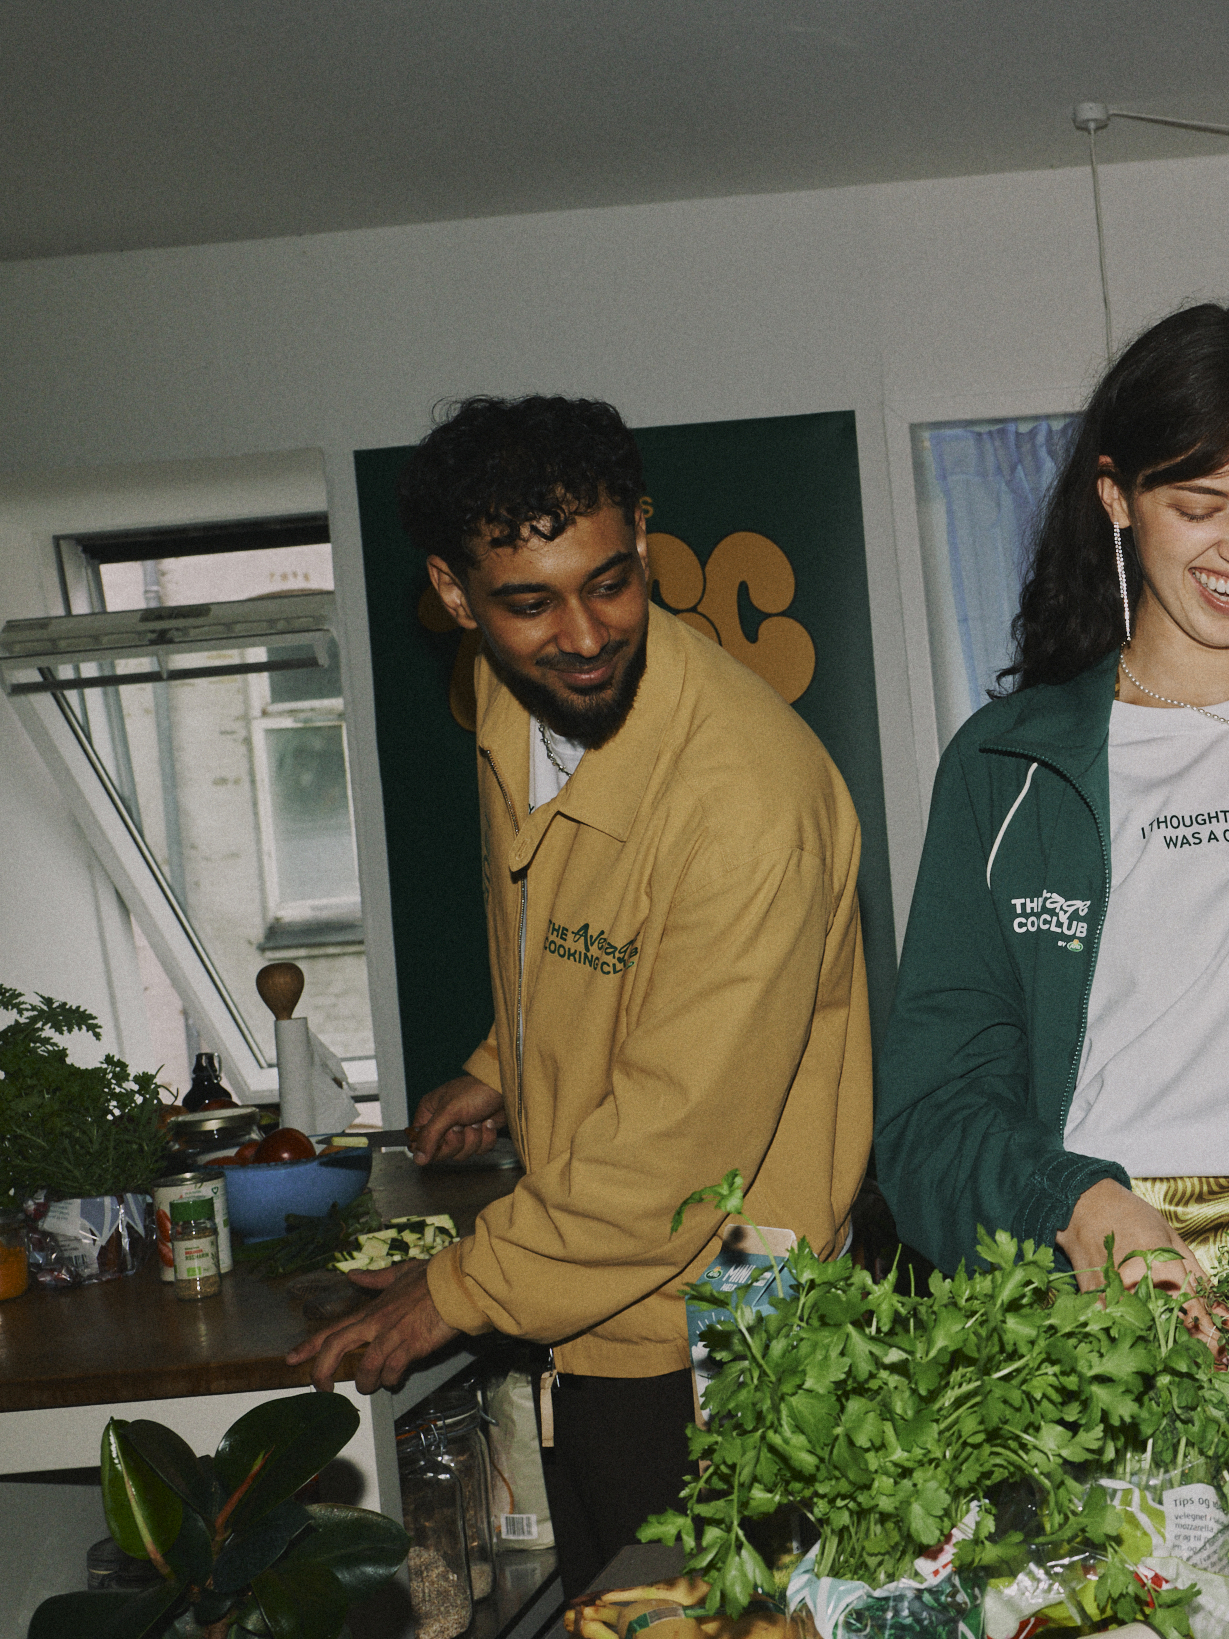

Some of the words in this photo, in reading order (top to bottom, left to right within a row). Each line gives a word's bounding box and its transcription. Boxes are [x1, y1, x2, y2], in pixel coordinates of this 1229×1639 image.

[1141, 826, 1146, 839] I
[1149, 810, 1229, 833] THOUGHT
[1163, 831, 1203, 850] WAS
[1207, 829, 1220, 843] A
[1039, 913, 1088, 938] CLUB
[1173, 1497, 1195, 1508] Tips
[1198, 1497, 1210, 1509] og
[1174, 1512, 1207, 1522] velegnet
[1174, 1522, 1214, 1533] mozzarella
